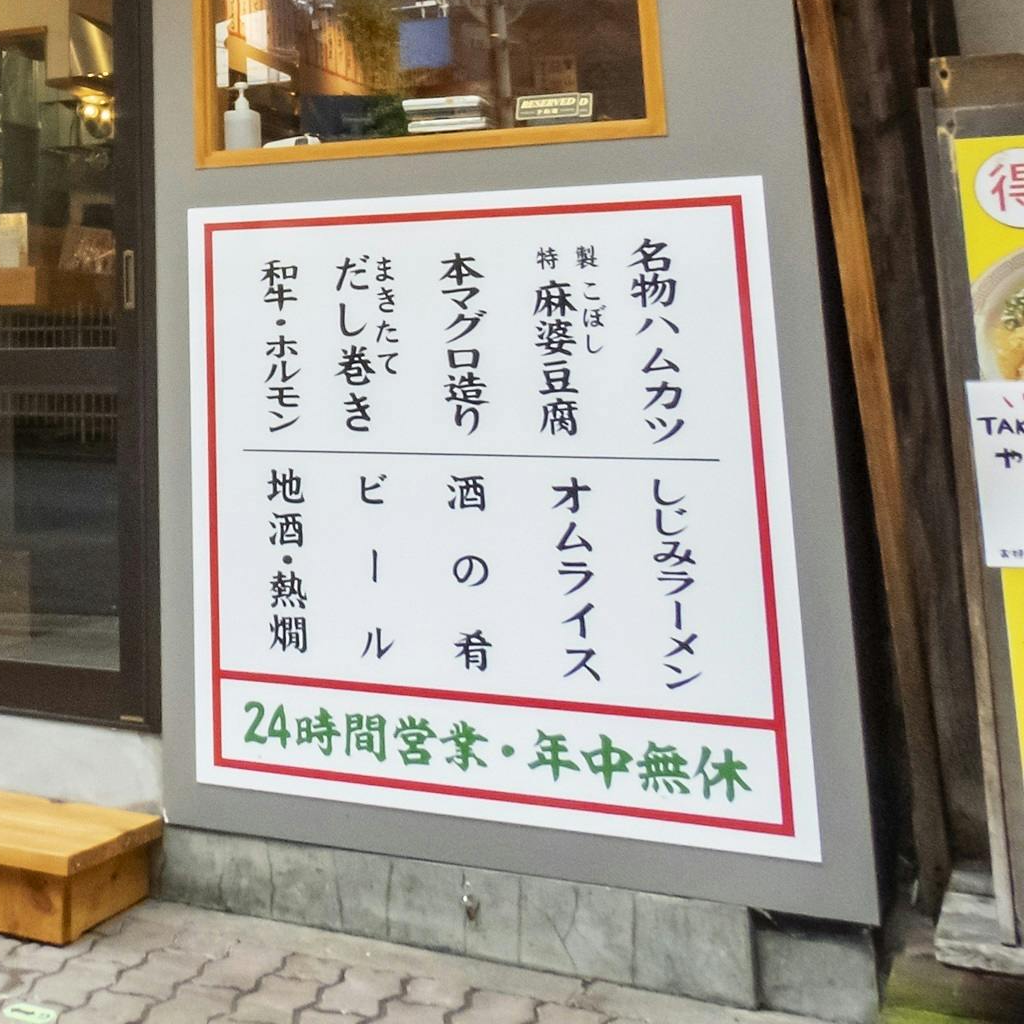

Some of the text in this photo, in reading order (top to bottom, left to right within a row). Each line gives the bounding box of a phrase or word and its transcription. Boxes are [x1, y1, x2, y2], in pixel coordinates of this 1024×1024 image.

[520, 97, 576, 109] RESERVED
[260, 259, 302, 433] 和牛・ホルモン
[335, 255, 376, 432] だし巻き
[376, 256, 399, 375] まきたて
[439, 252, 490, 436] 本マグロ造り
[533, 280, 578, 436] 麻婆豆腐
[582, 281, 607, 354] こぼし
[628, 238, 685, 445] 名物ハムカツ
[360, 474, 395, 660] ビール
[447, 475, 492, 672] 酒の肴
[551, 477, 601, 682] オムライス
[653, 479, 703, 690] しじみラーメン
[244, 700, 752, 803] 24時間営業・年中無休
